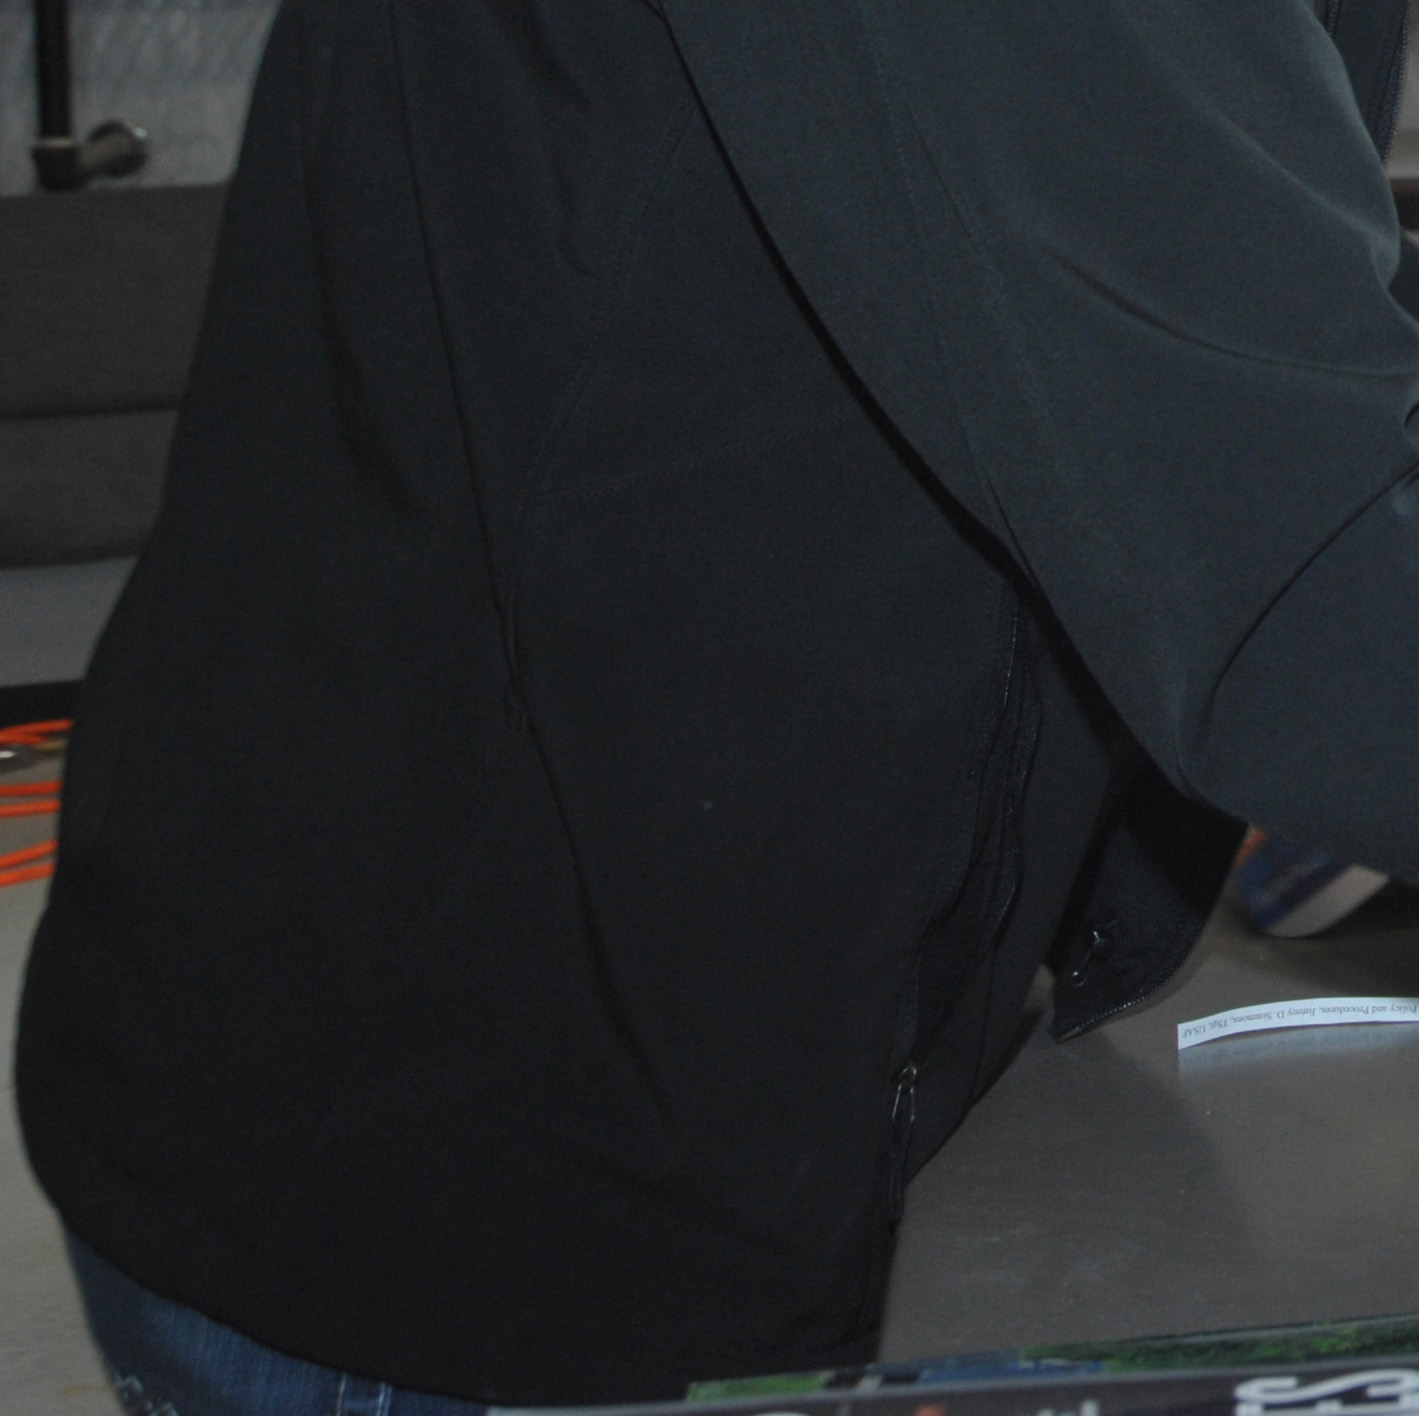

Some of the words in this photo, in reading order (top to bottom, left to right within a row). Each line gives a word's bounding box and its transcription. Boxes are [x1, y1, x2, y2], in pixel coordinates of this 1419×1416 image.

[1287, 1007, 1316, 1017] Jimmy
[1319, 1005, 1369, 1016] Procedures,
[1372, 1005, 1388, 1015] and
[1390, 1003, 1418, 1014] Policy
[1231, 1011, 1272, 1024] Simmons,
[1182, 1025, 1206, 1039] USAF
